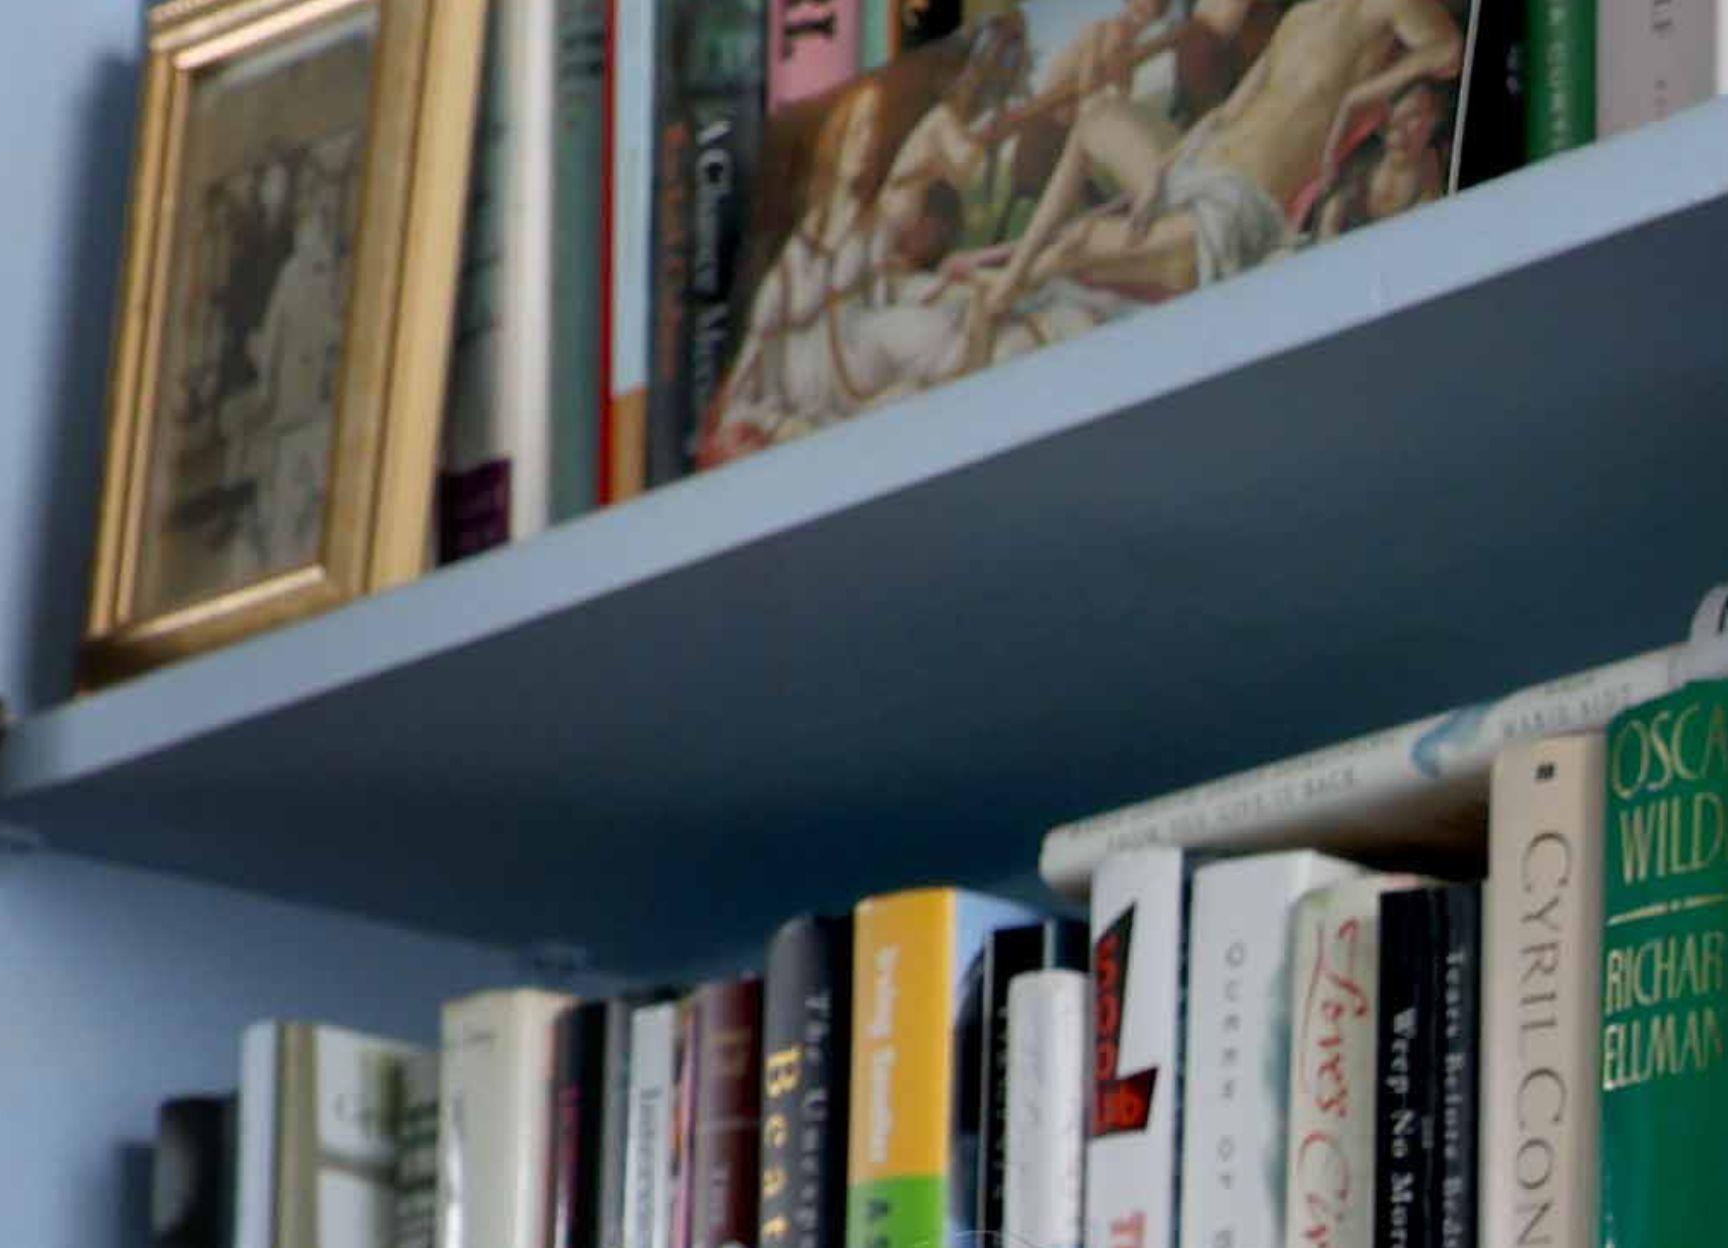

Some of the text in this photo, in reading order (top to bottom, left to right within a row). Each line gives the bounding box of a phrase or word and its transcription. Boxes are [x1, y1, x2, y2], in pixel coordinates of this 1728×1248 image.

[1516, 827, 1574, 1053] CYRIL
[1386, 1007, 1418, 1095] Weep
[1390, 1110, 1416, 1157] No
